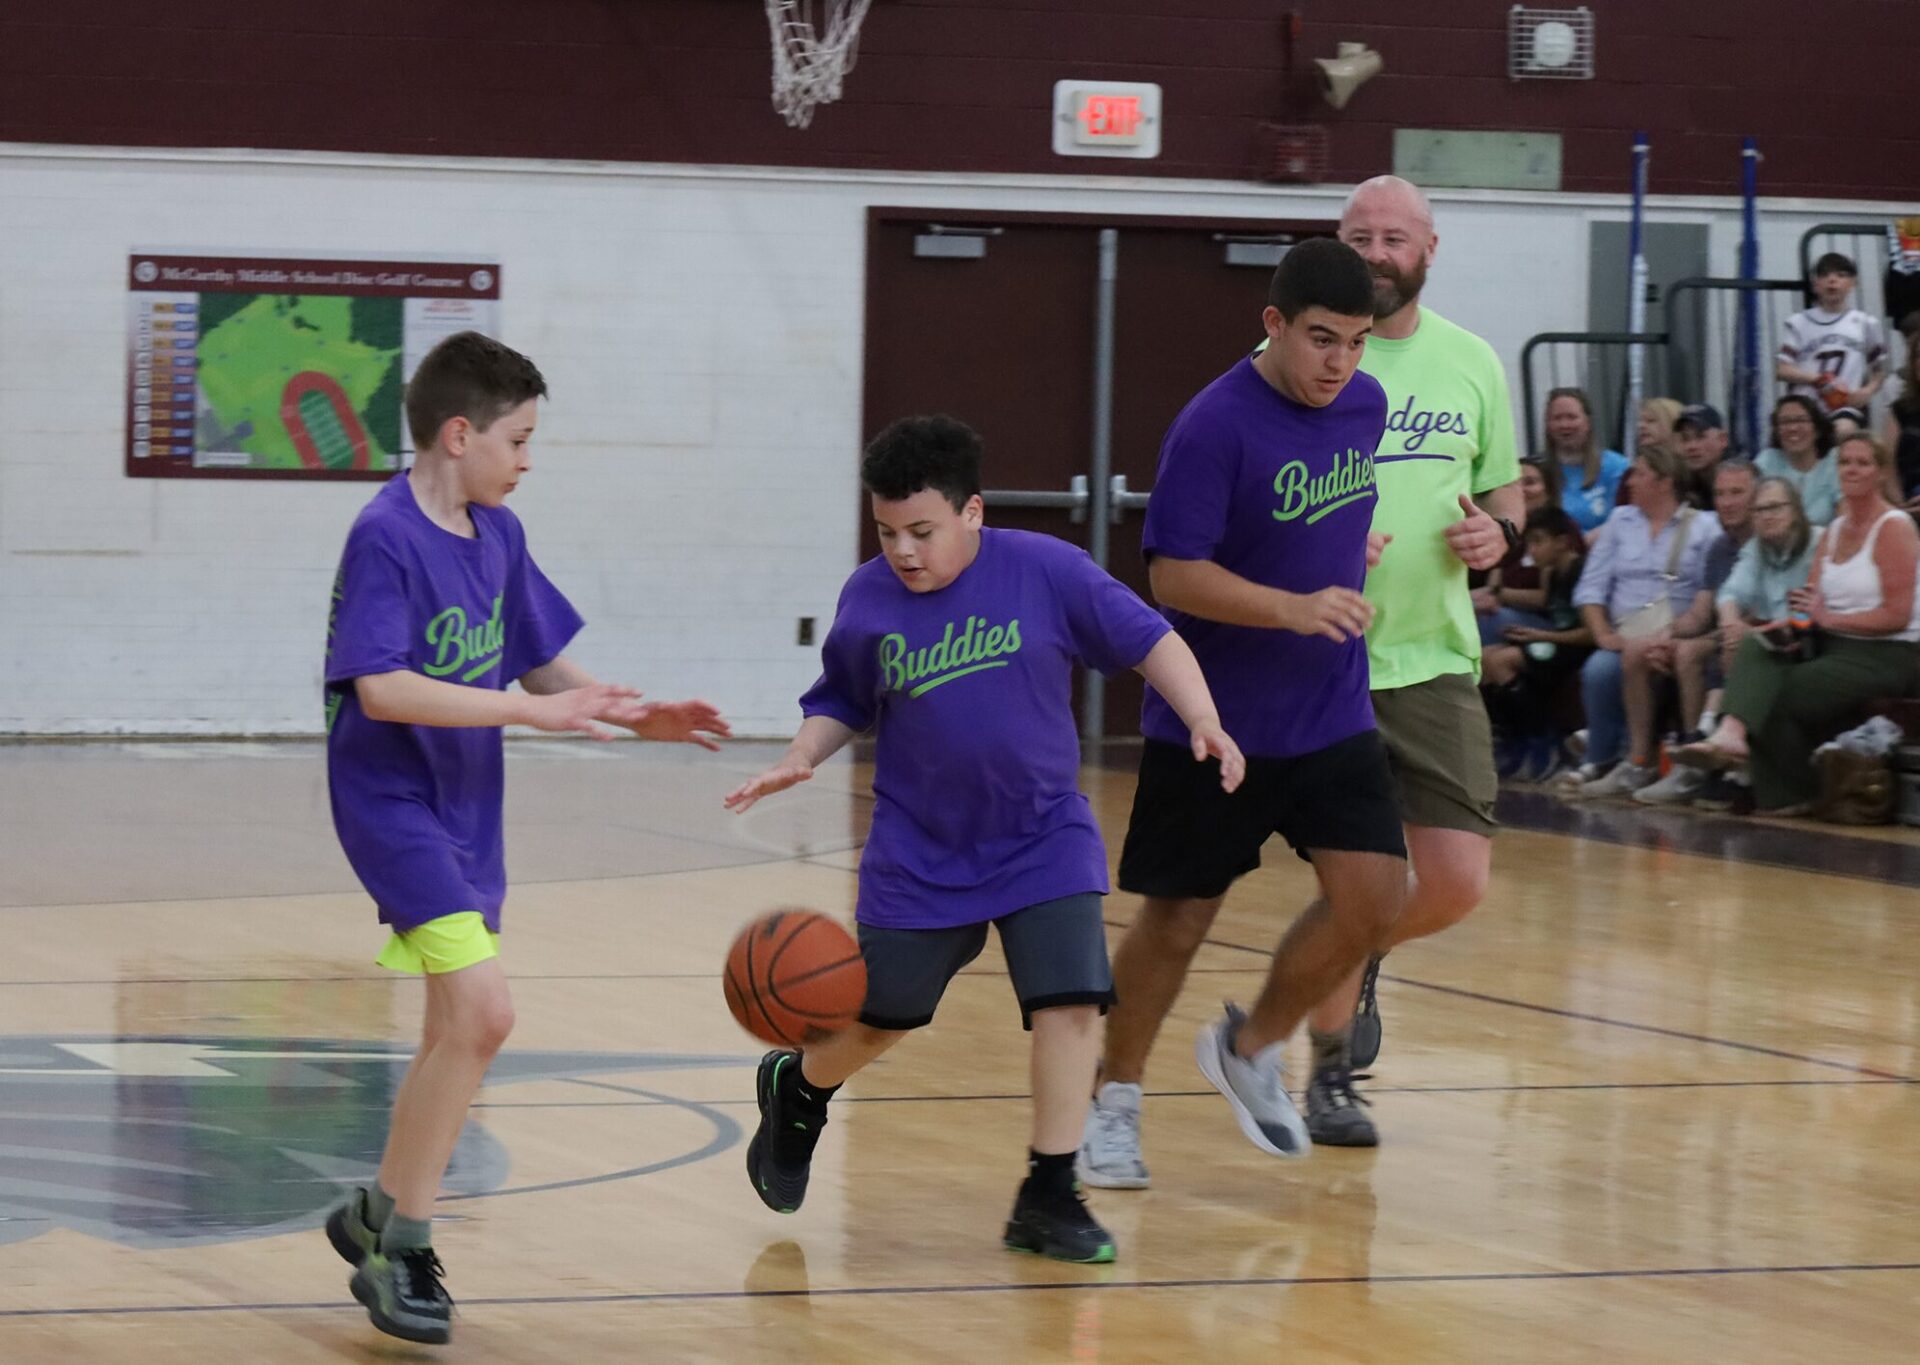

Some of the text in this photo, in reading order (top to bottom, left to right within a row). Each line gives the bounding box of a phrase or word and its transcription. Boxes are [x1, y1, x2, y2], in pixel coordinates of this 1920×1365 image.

[1087, 95, 1140, 136] EXIT
[1385, 395, 1469, 451] dges
[879, 615, 1022, 690] Buddies
